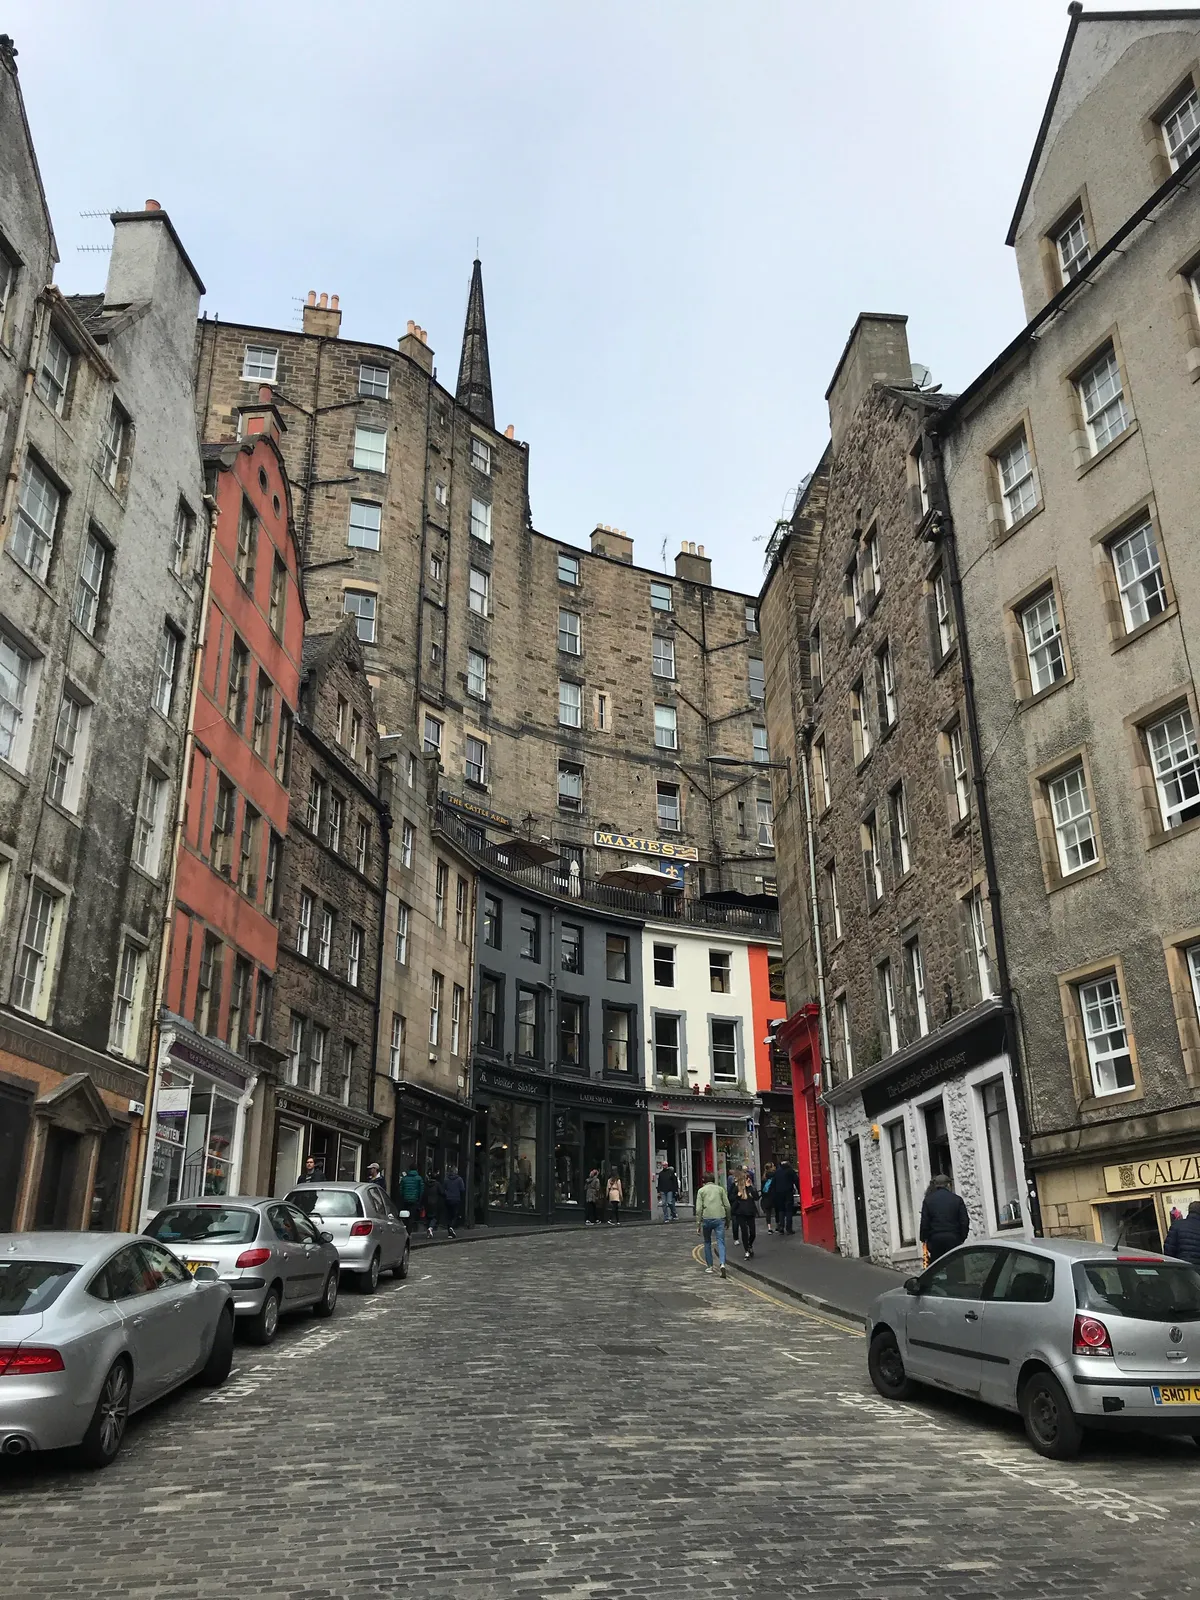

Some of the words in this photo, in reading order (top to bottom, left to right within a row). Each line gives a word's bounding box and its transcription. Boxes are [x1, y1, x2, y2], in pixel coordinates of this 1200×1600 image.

[448, 796, 462, 806] THE
[598, 833, 674, 855] MAXIES
[279, 1099, 287, 1109] 89
[200, 1365, 287, 1403] PERMIT
[1162, 1388, 1190, 1402] SM07
[825, 1391, 947, 1430] PERMIT
[958, 1450, 1170, 1523] HOLDERS
